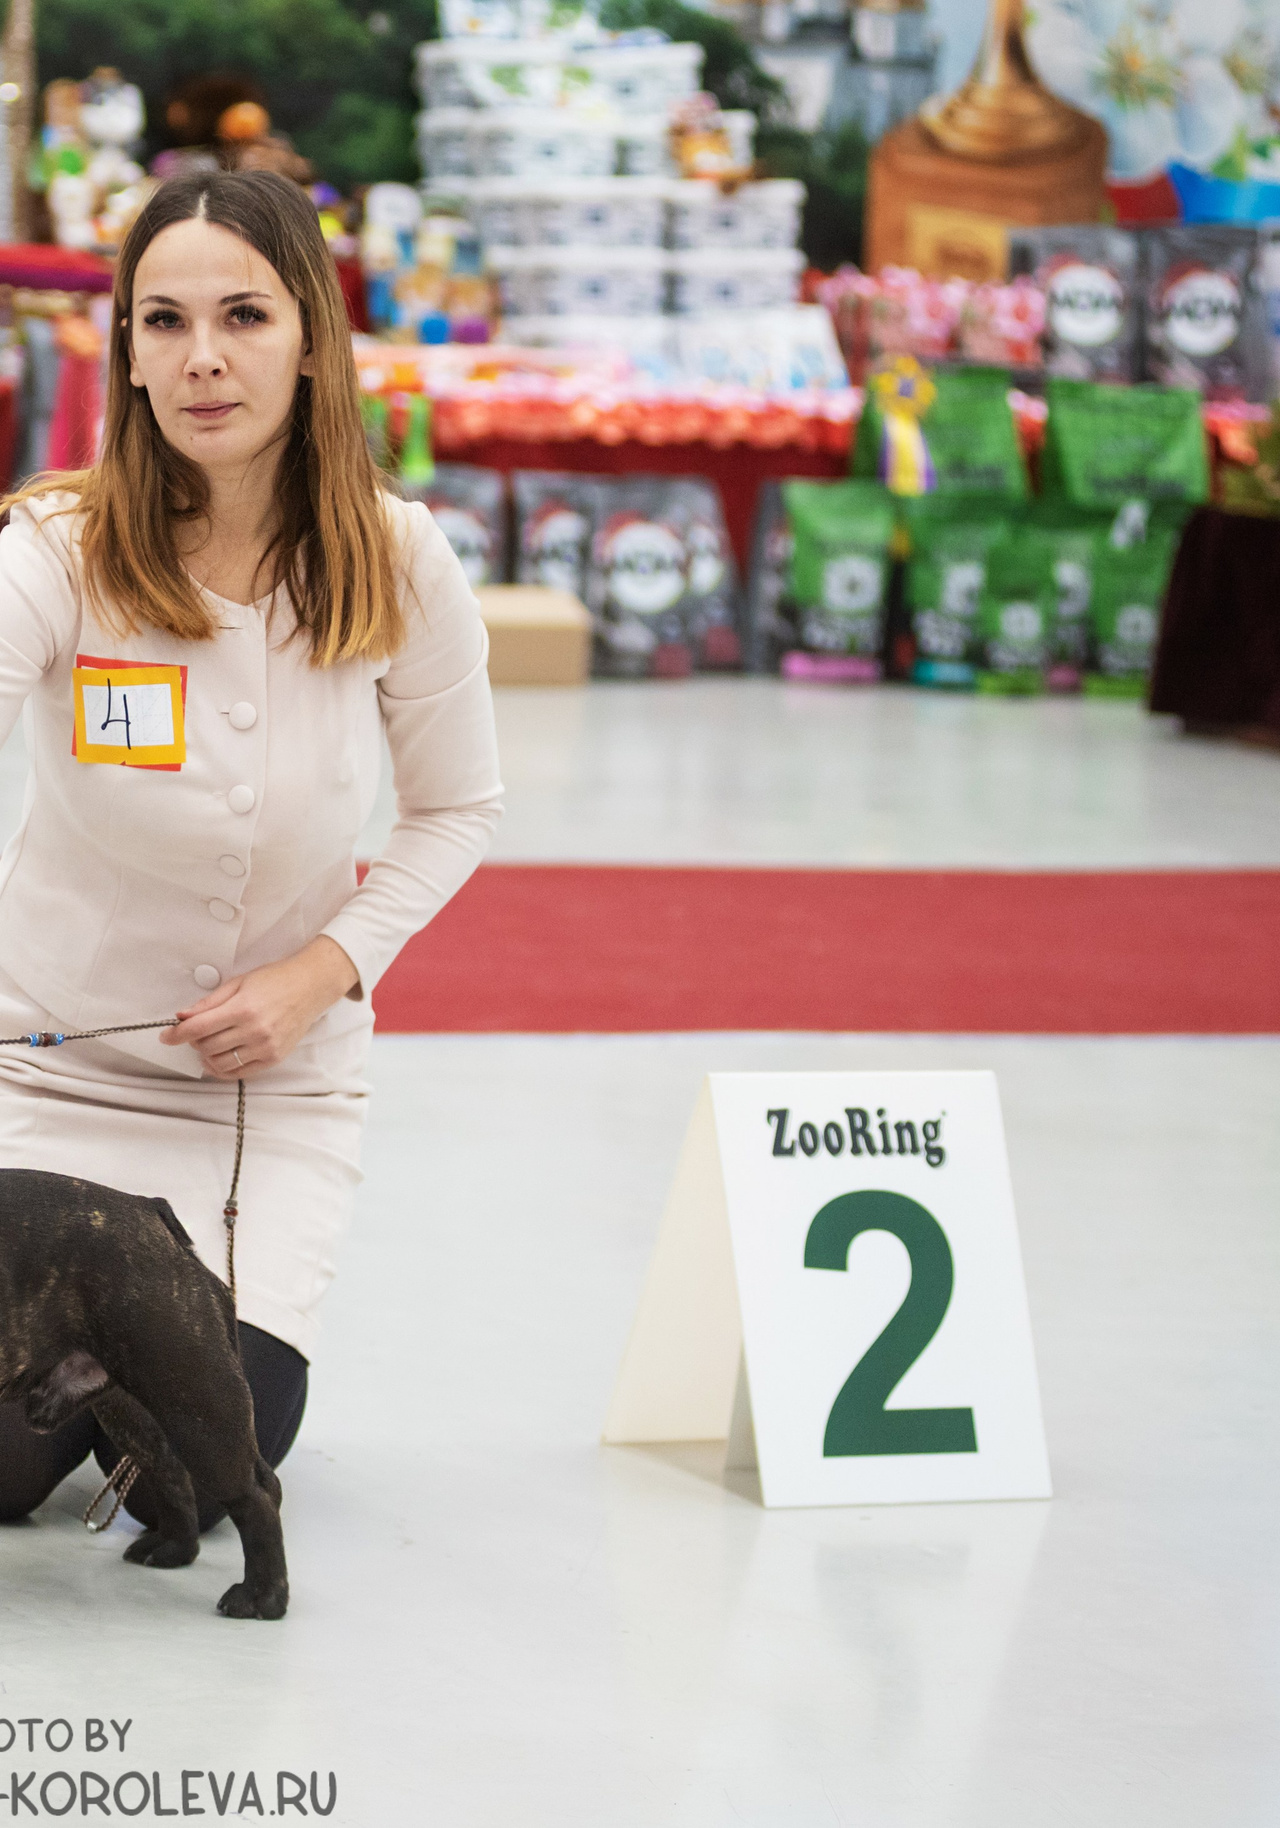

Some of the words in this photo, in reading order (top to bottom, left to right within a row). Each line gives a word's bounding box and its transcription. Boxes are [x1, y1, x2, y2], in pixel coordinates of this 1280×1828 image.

[101, 678, 131, 750] 4
[766, 1107, 947, 1169] ZooRing
[803, 1188, 979, 1459] 2
